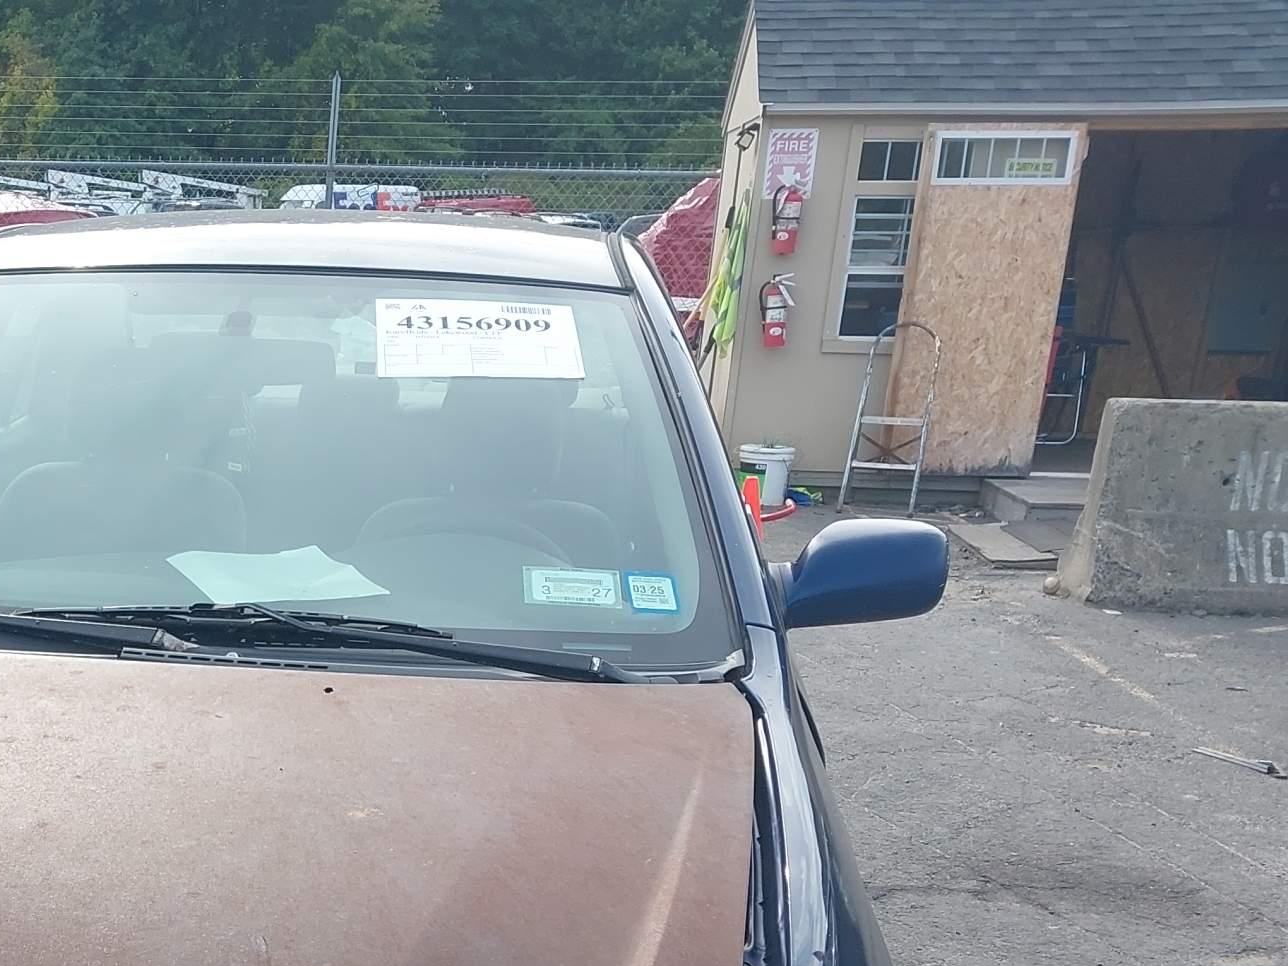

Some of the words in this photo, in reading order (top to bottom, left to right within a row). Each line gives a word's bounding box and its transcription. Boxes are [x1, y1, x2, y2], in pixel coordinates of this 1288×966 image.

[776, 140, 809, 151] FIRE
[397, 315, 551, 333] 43156909
[541, 585, 551, 595] 3
[591, 587, 613, 598] 27
